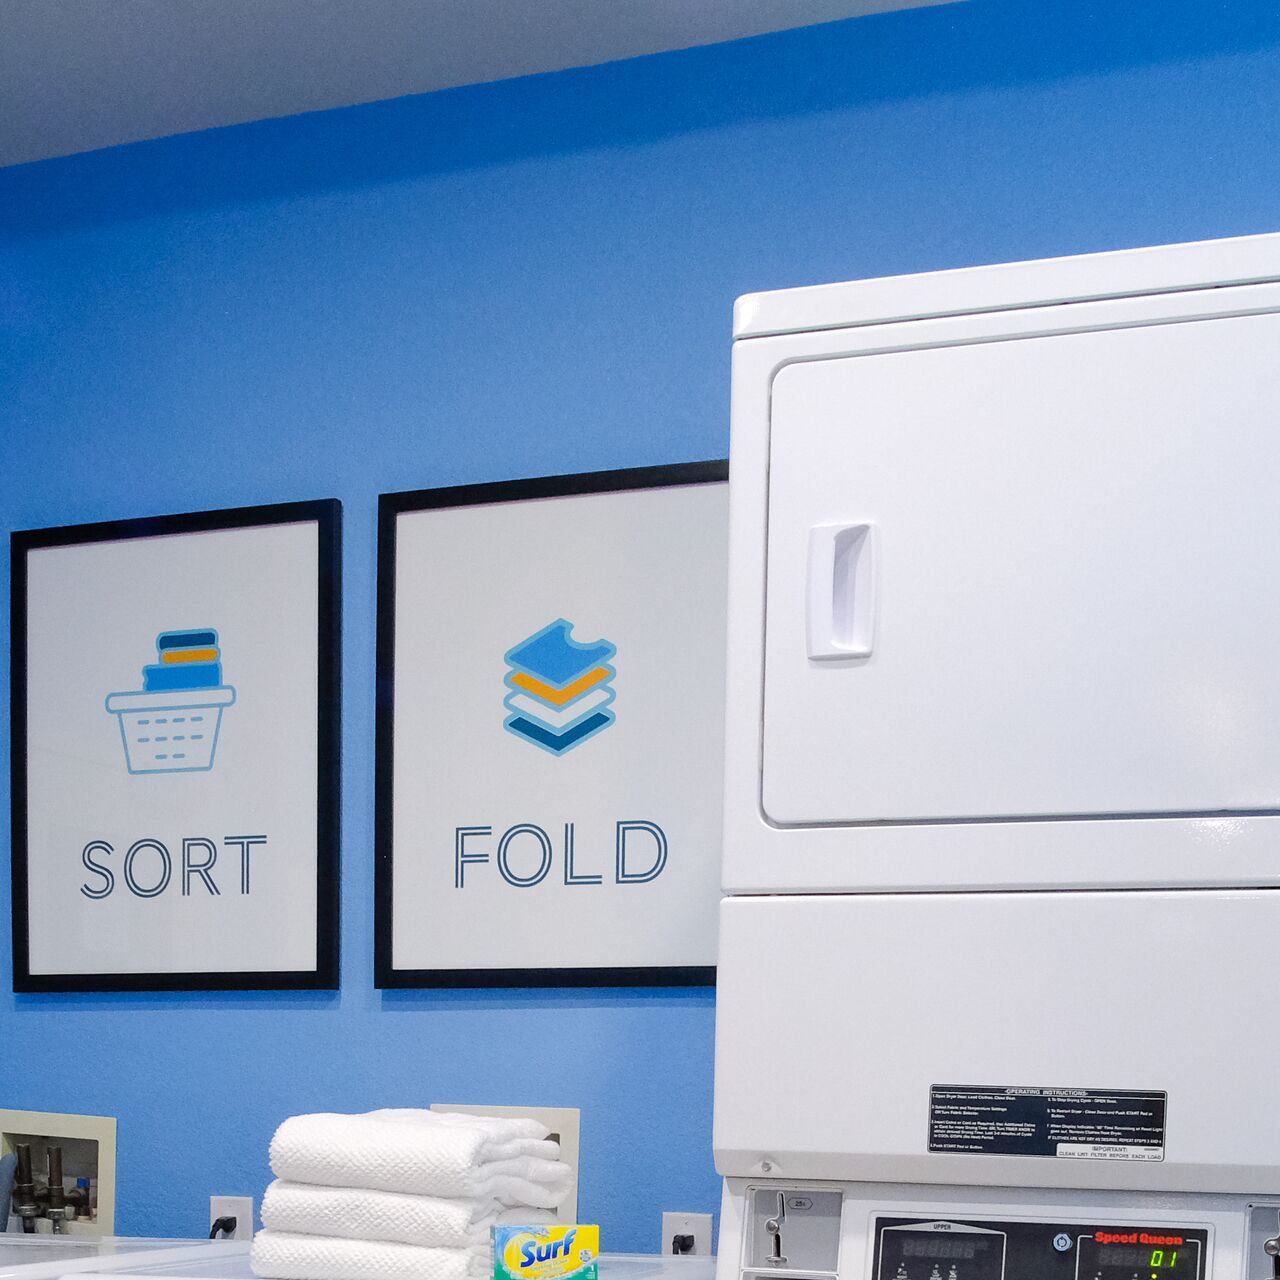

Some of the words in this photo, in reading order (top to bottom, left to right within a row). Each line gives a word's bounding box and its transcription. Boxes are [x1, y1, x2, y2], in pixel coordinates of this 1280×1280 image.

[80, 833, 268, 900] SORT
[454, 819, 669, 890] FOLD
[520, 1229, 577, 1268] Surf
[1095, 1231, 1138, 1244] Speed
[1139, 1233, 1184, 1245] Queen
[1150, 1250, 1178, 1268] 01
